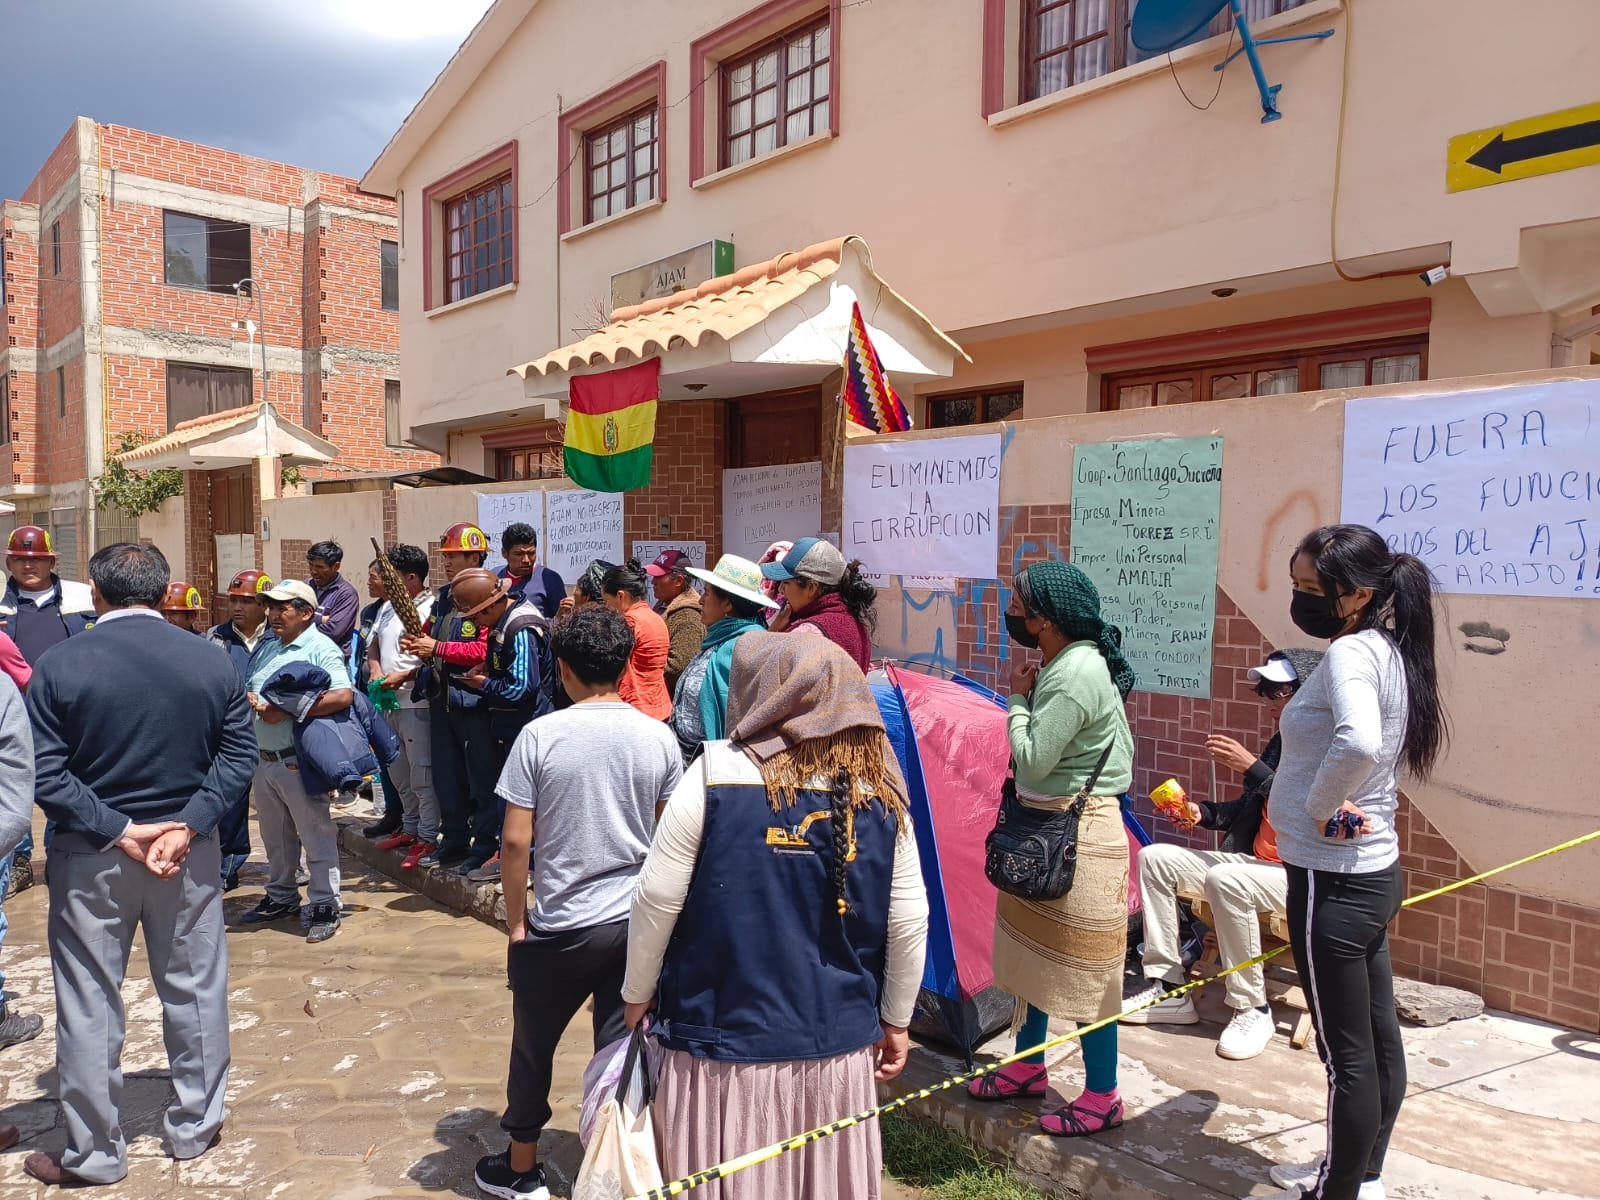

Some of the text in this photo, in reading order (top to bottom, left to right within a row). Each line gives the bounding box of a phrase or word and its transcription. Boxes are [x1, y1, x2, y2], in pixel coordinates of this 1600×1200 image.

[656, 266, 687, 290] AJAM
[1383, 409, 1550, 464] FUERA
[871, 455, 998, 488] ELIMINEMOS
[491, 496, 532, 519] BASTA
[910, 490, 934, 515] LA
[1119, 498, 1166, 518] Minera
[1376, 470, 1600, 524] LOS FUNCI
[550, 508, 572, 525] AJAM
[589, 500, 621, 518] RESPETA
[852, 508, 991, 544] CORRUPCION
[1455, 527, 1493, 557] DEL
[1529, 518, 1600, 562] AJ
